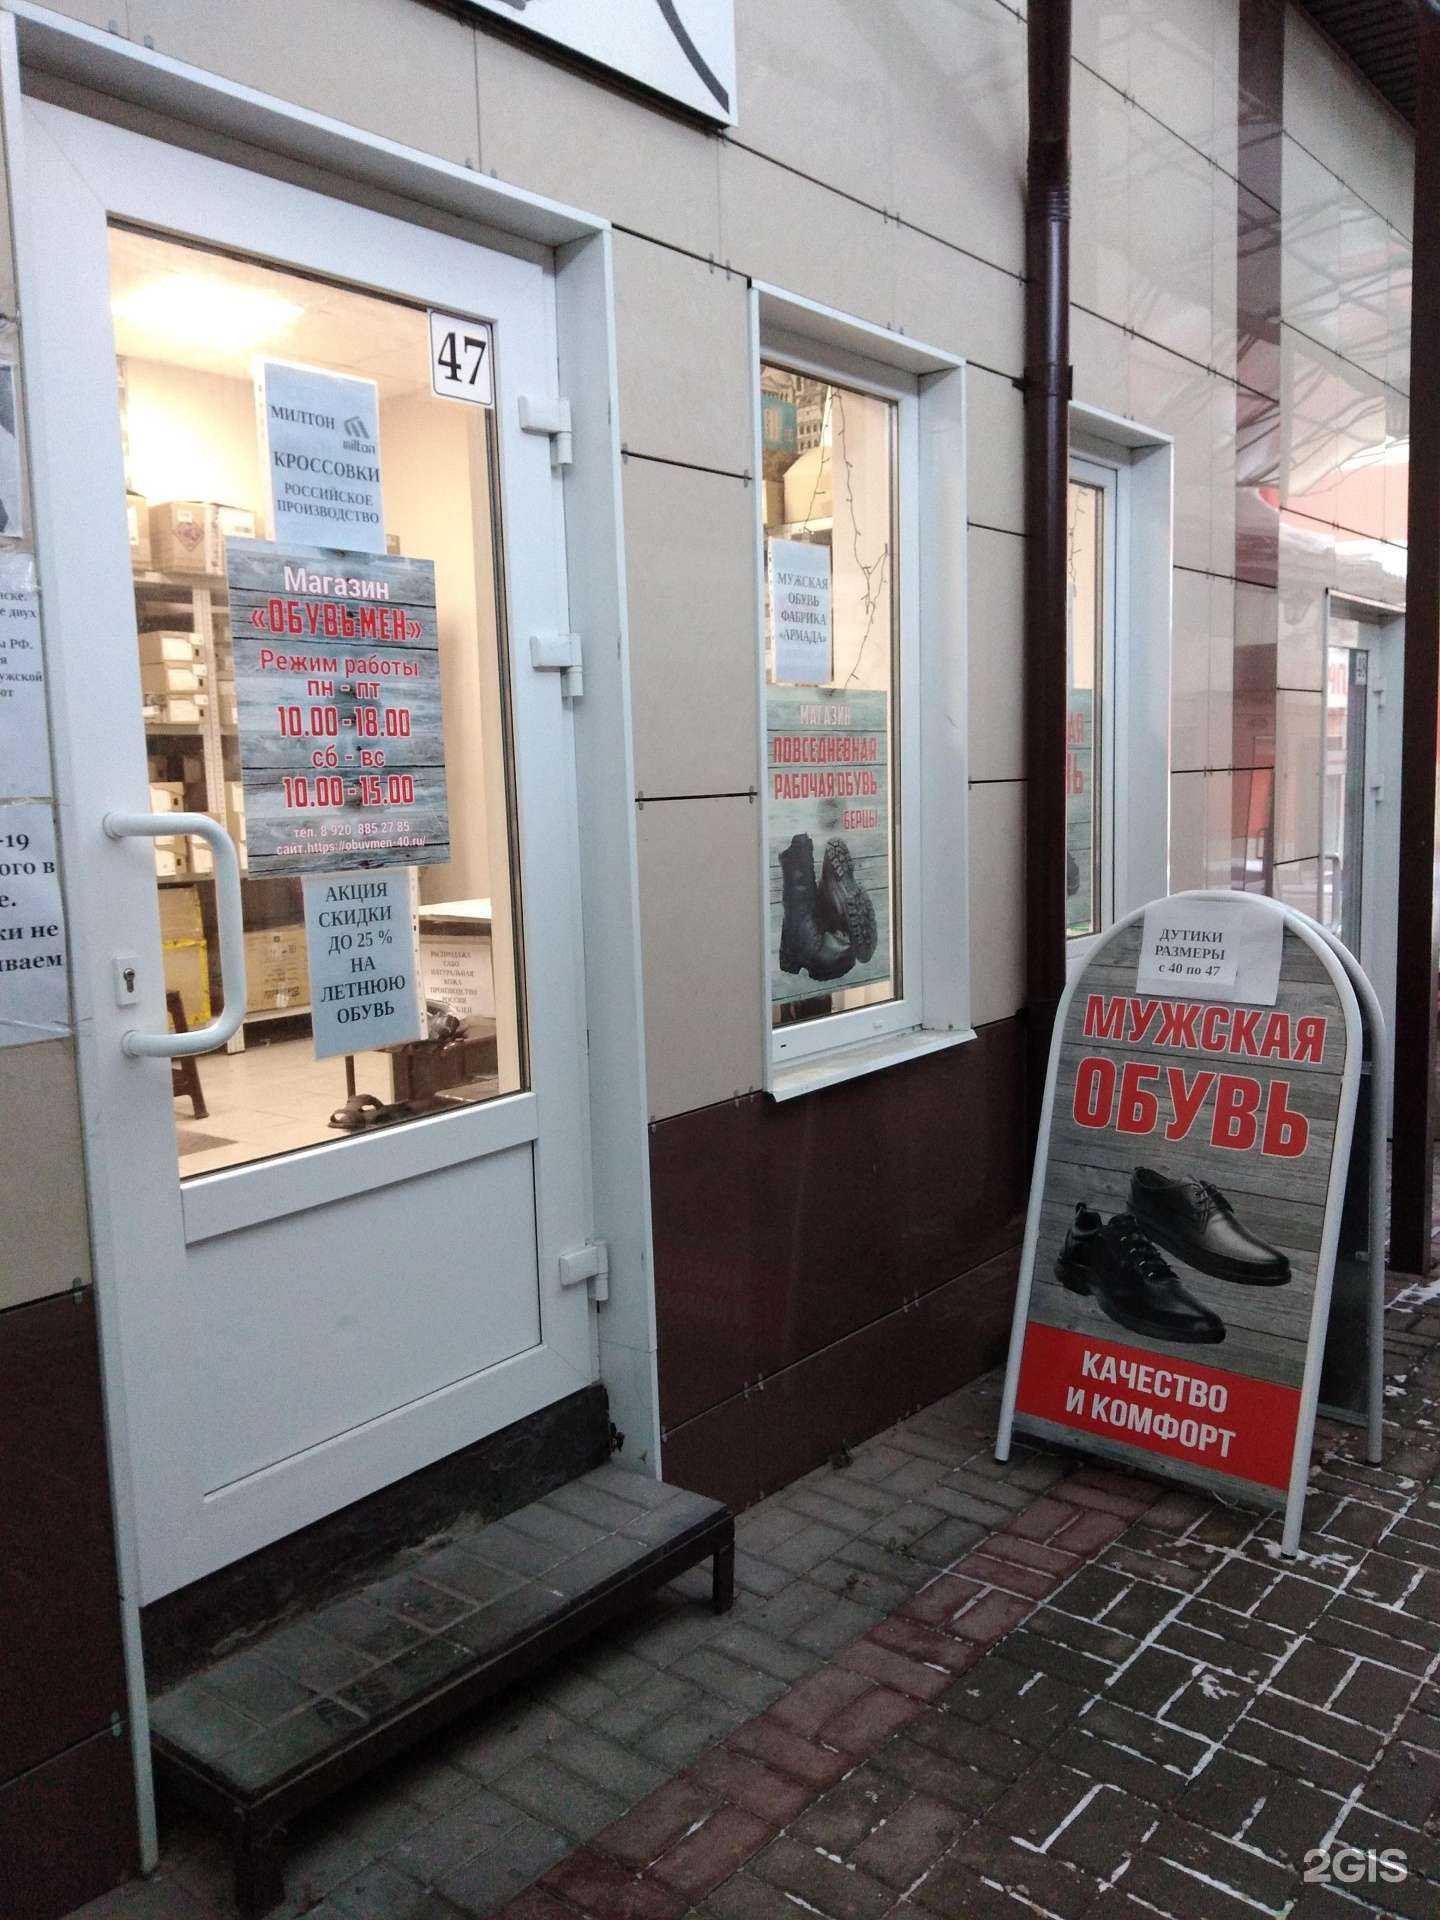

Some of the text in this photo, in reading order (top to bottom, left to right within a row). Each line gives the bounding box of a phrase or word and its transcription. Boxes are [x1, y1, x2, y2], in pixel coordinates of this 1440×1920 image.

[438, 332, 486, 386] 47
[271, 405, 335, 430] МИЛТОН
[274, 451, 380, 482] КРОССОВКИ
[284, 482, 373, 506] РОССИЙСКОЕ
[276, 499, 379, 524] ПРОИЗВОДСТВО
[283, 566, 390, 600] Магазин
[777, 573, 828, 590] МУЖСКАЯ
[788, 592, 819, 607] ОБУВЬ
[9, 608, 37, 618] двух
[251, 598, 423, 641] «ОБУВЬМЕН»
[780, 610, 826, 625] ФАБРИКА
[260, 649, 420, 678] Режим работы
[800, 704, 850, 725] МАГАЗИН
[311, 745, 339, 767] сб
[773, 735, 877, 764] ПОВСЕДНЕВНАЯ
[773, 770, 877, 799] РАБОЧАЯ ОБУВЬ
[320, 824, 327, 836] 8
[332, 824, 352, 836] 920
[358, 821, 378, 834] 885
[381, 821, 394, 833] 27
[397, 820, 410, 832] 85
[43, 861, 55, 873] в
[325, 882, 388, 904] АКЦИЯ
[318, 906, 392, 928] СКИДКИ
[31, 923, 59, 938] не
[328, 929, 393, 955] ДО 25 %
[1160, 928, 1222, 943] ДУТИКИ
[351, 954, 376, 974] НА
[1155, 945, 1225, 960] РАЗМЕРЫ
[1168, 963, 1183, 974] 40
[1187, 966, 1202, 975] по
[1205, 966, 1221, 977] 47
[320, 975, 406, 1003] ЛЕТНЮЮ
[337, 1001, 395, 1024] ОБУВЬ
[1083, 994, 1328, 1064] МУЖСКАЯ
[1073, 1056, 1310, 1158] ОБУВЬ
[1081, 1350, 1228, 1413] КАЧЕСТВО
[1065, 1386, 1236, 1458] И КОМФОРТ
